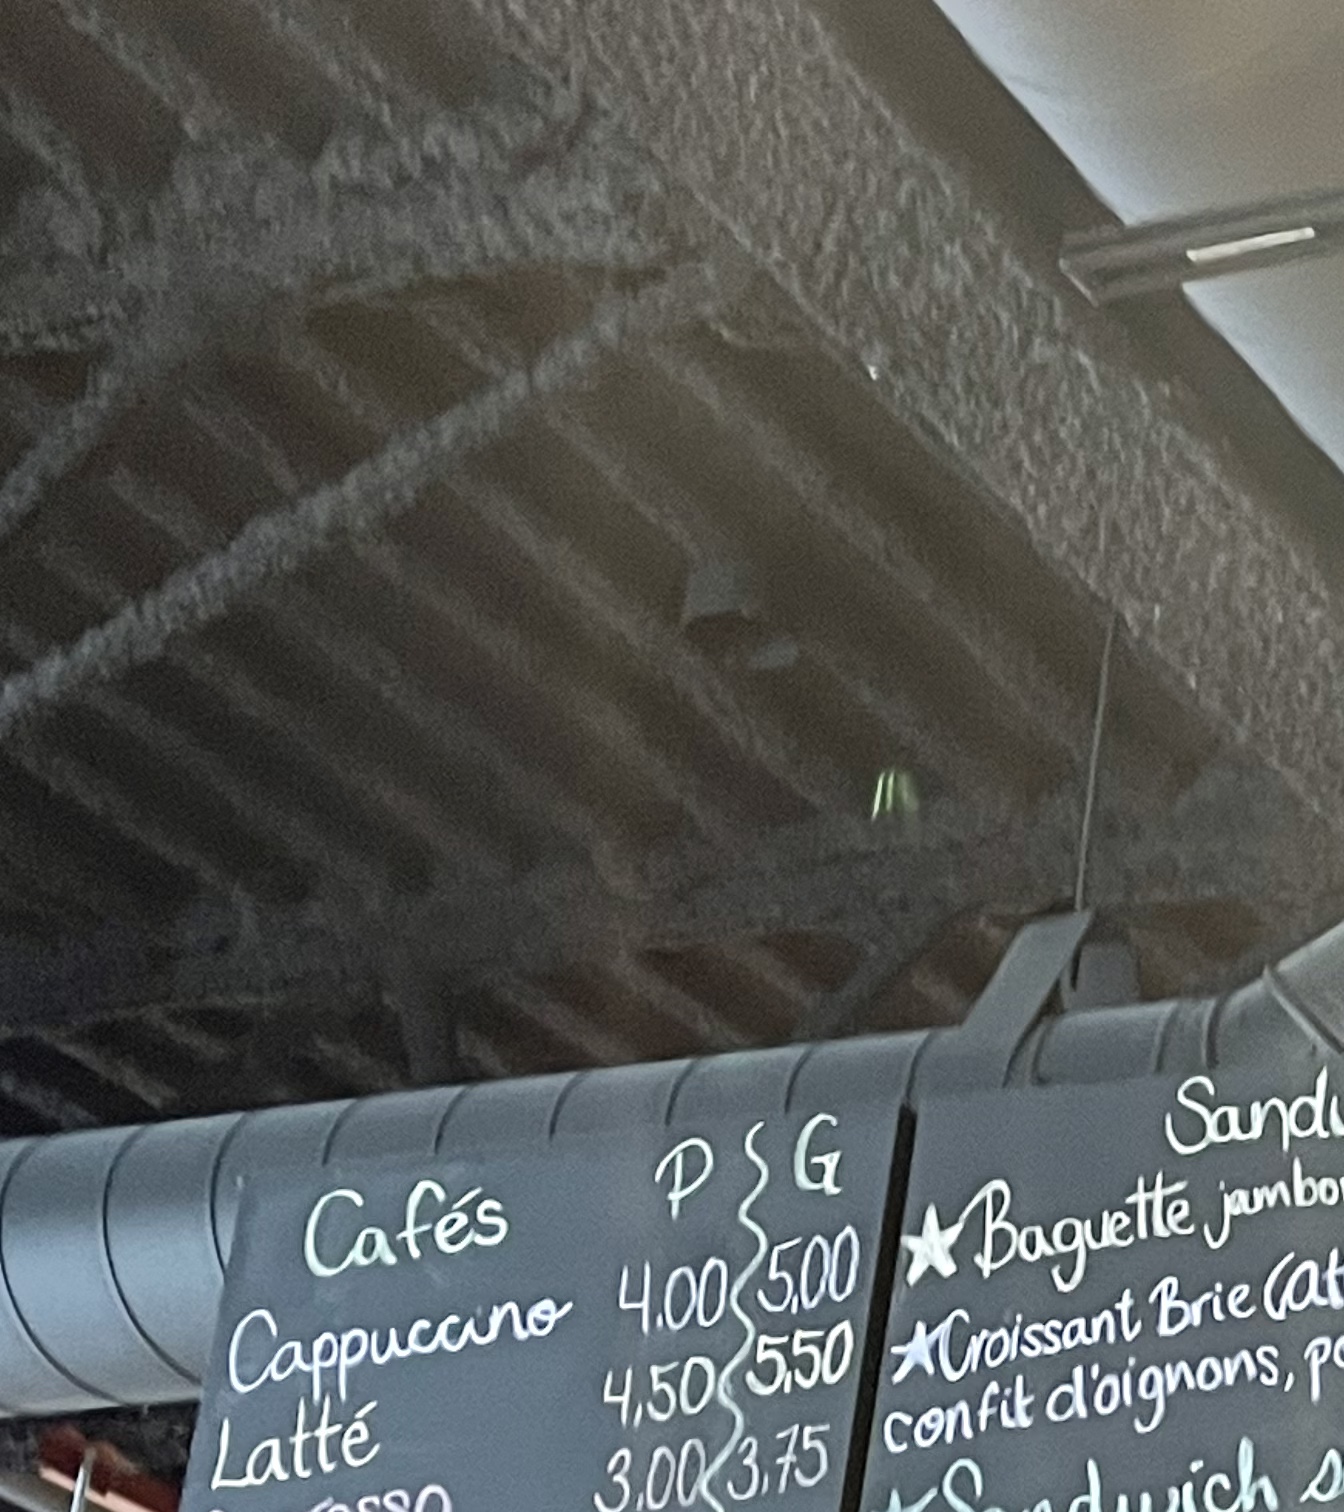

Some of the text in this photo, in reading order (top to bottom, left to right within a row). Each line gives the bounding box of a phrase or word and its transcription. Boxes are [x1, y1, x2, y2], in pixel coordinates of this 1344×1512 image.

[303, 1113, 843, 1277] Cafés P G
[957, 1172, 1194, 1292] Baguette
[228, 1296, 574, 1401] Cappuccino
[935, 1288, 1140, 1383] Croissant
[1150, 1276, 1253, 1337] Brie
[211, 1396, 380, 1490] Latté
[882, 1372, 1033, 1454] confit
